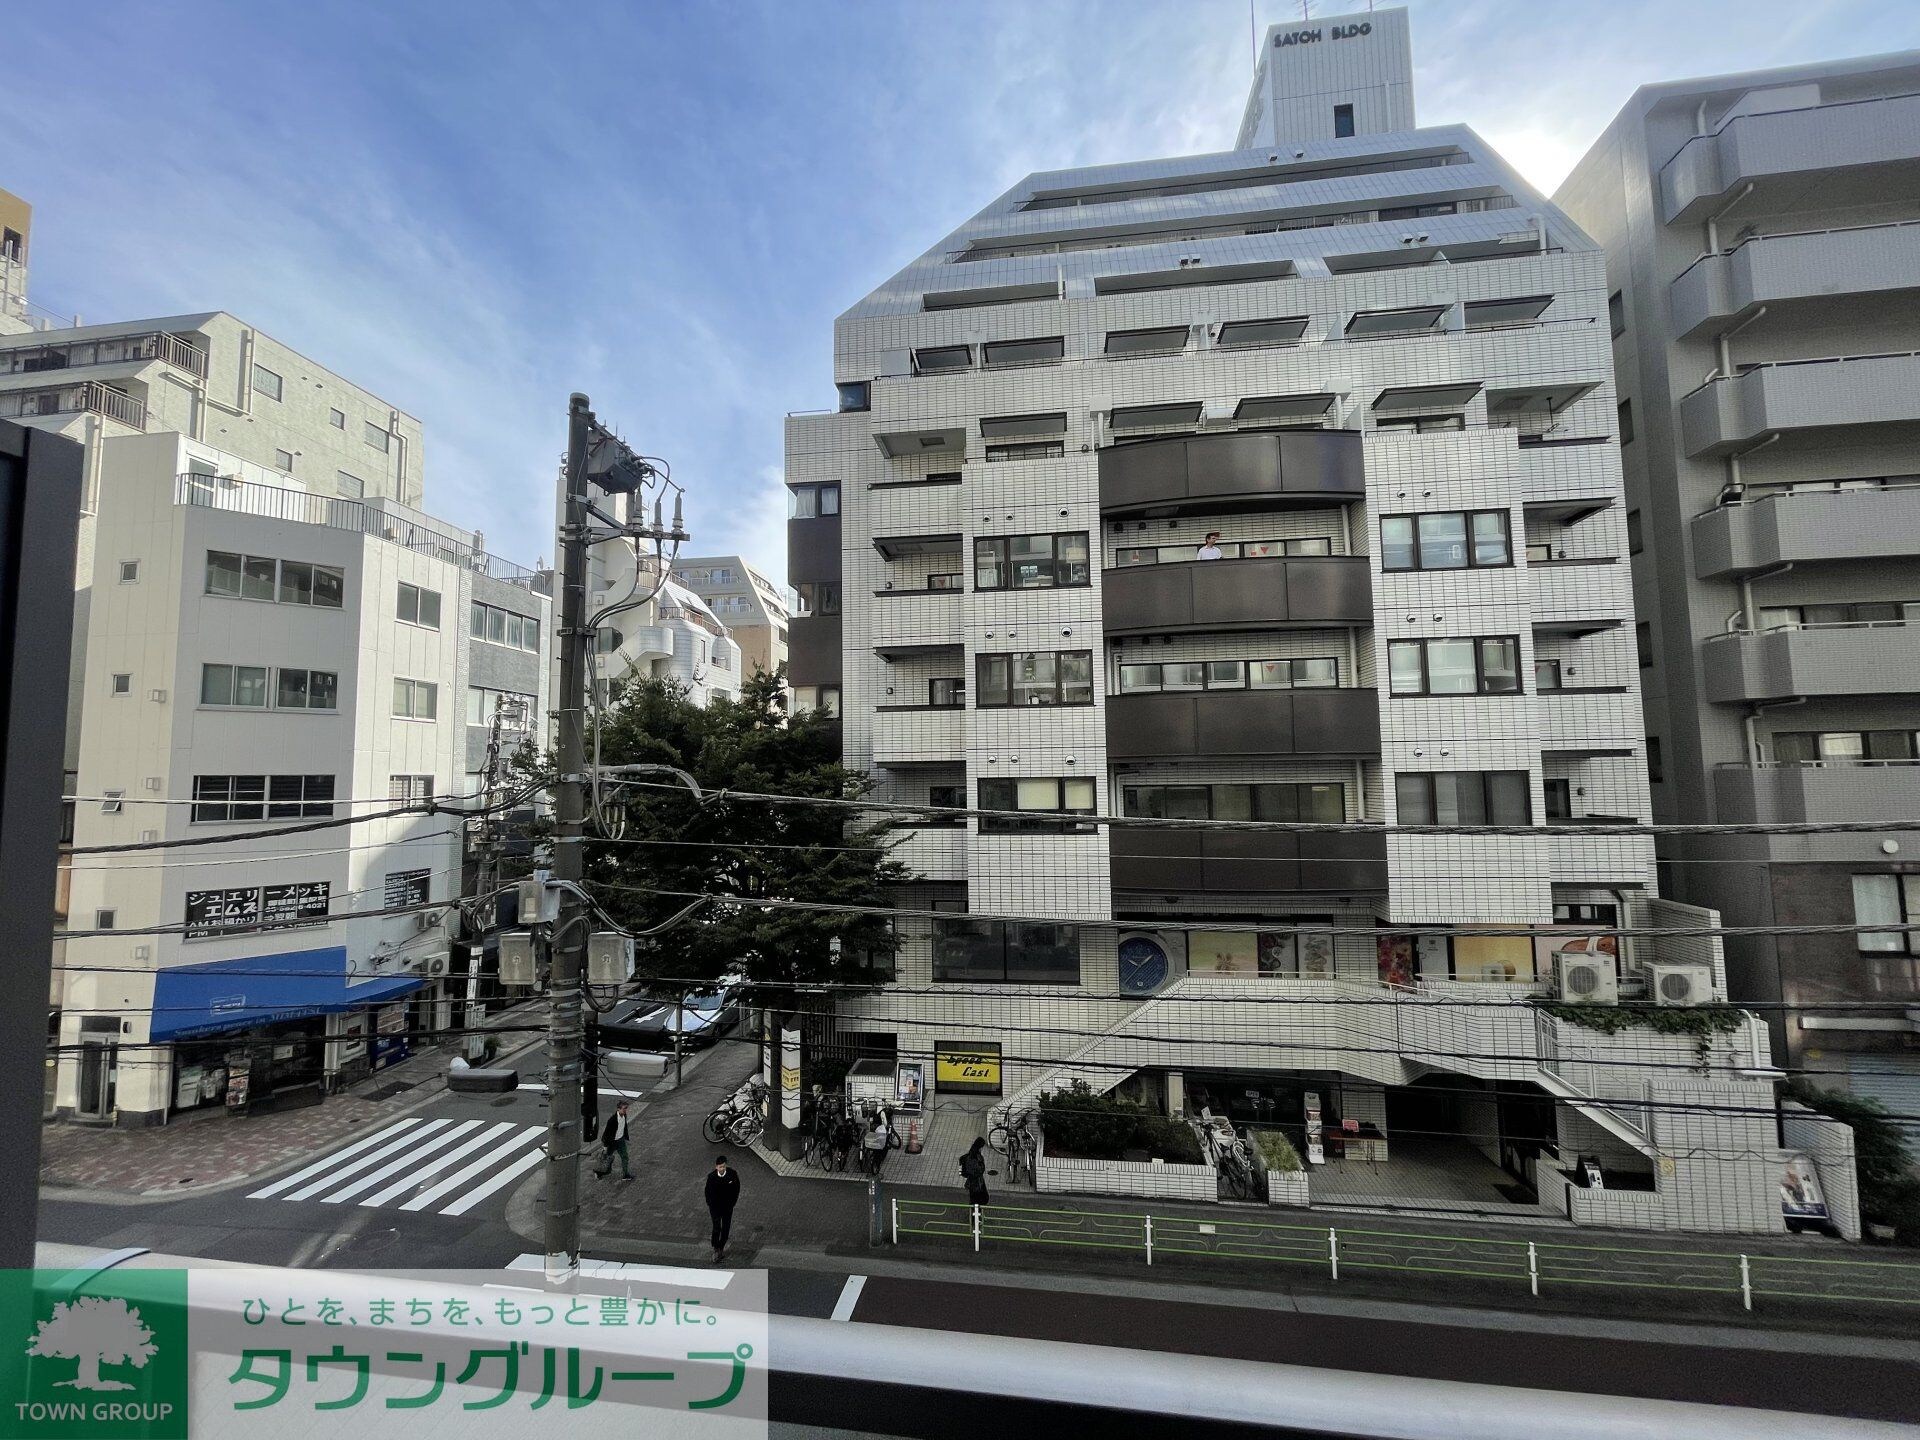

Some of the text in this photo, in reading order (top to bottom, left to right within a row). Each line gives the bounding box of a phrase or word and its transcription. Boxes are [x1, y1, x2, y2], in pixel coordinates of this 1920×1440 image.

[1274, 22, 1372, 48] SATOH BLDG
[189, 883, 328, 906] ジュエリーメッキ
[962, 1066, 990, 1078] Cast
